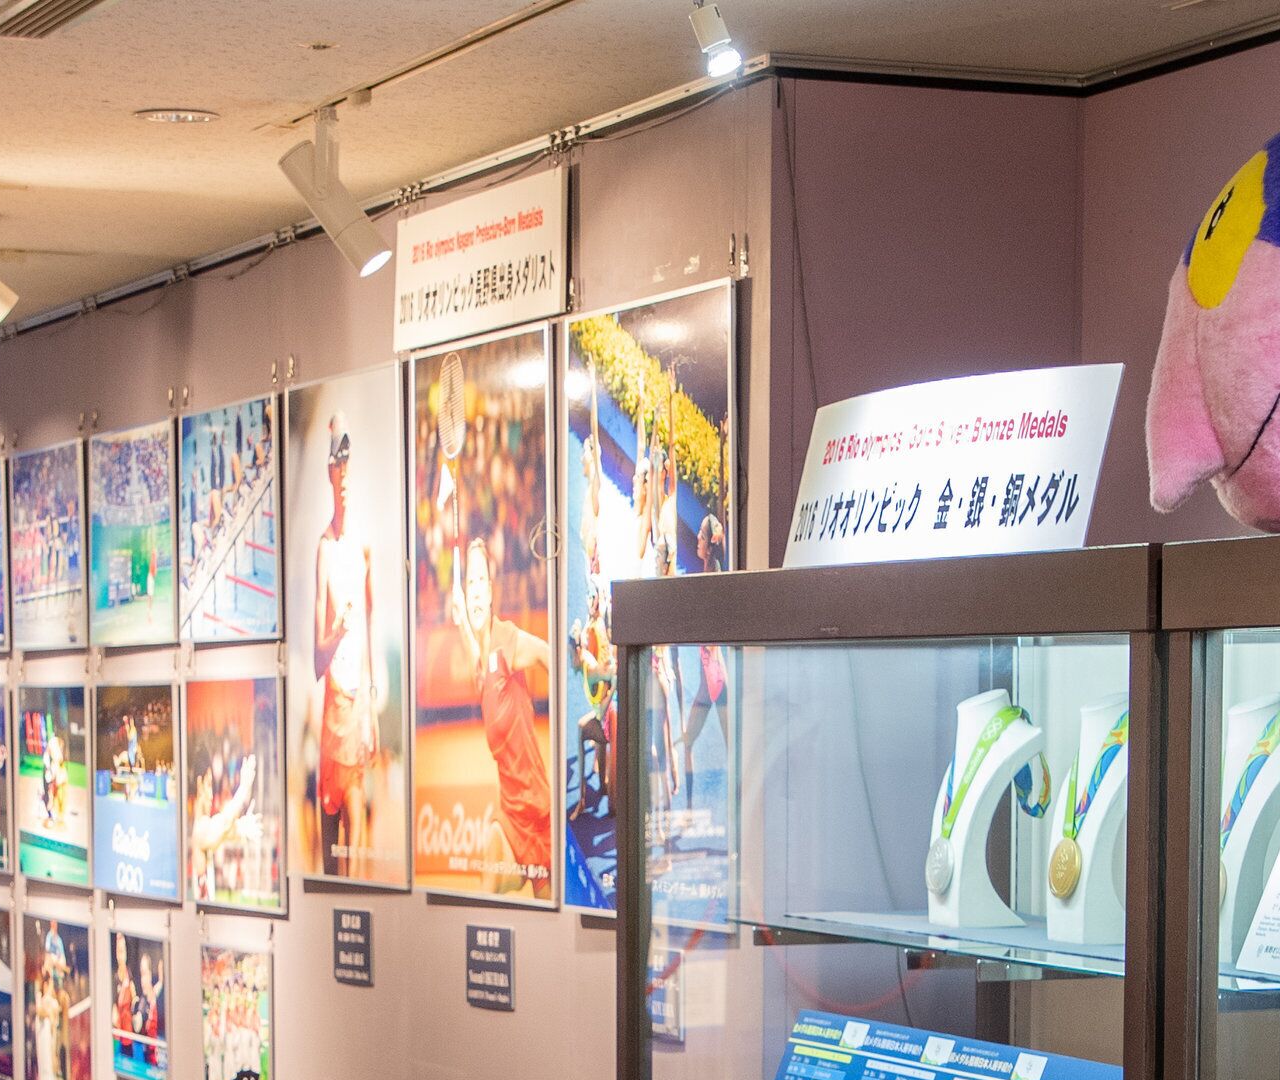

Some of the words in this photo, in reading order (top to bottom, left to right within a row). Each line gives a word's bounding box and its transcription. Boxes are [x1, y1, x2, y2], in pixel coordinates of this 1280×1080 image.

[823, 433, 846, 465] 2016
[1017, 410, 1069, 441] Medals
[794, 502, 818, 542] 2016
[819, 482, 922, 541] リオオリンピック
[933, 470, 1080, 530] 金・銀・銅メダル
